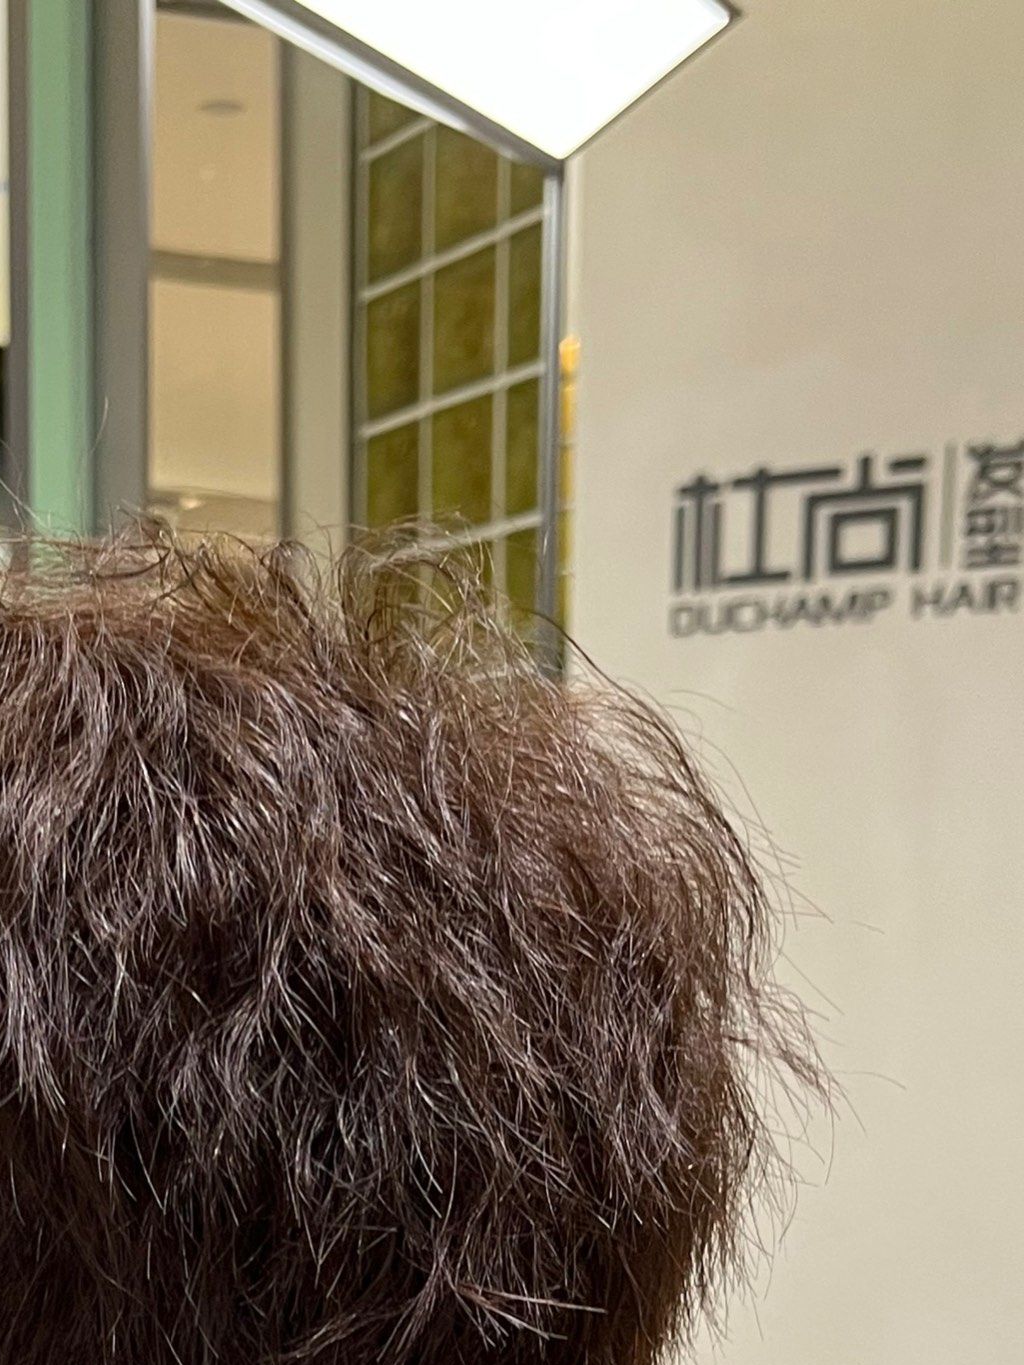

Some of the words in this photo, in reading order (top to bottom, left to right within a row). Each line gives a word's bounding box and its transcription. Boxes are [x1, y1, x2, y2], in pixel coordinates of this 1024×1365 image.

[673, 455, 929, 592] 杜尚
[670, 588, 891, 638] DUCHAMP
[910, 578, 1021, 620] HAIR
